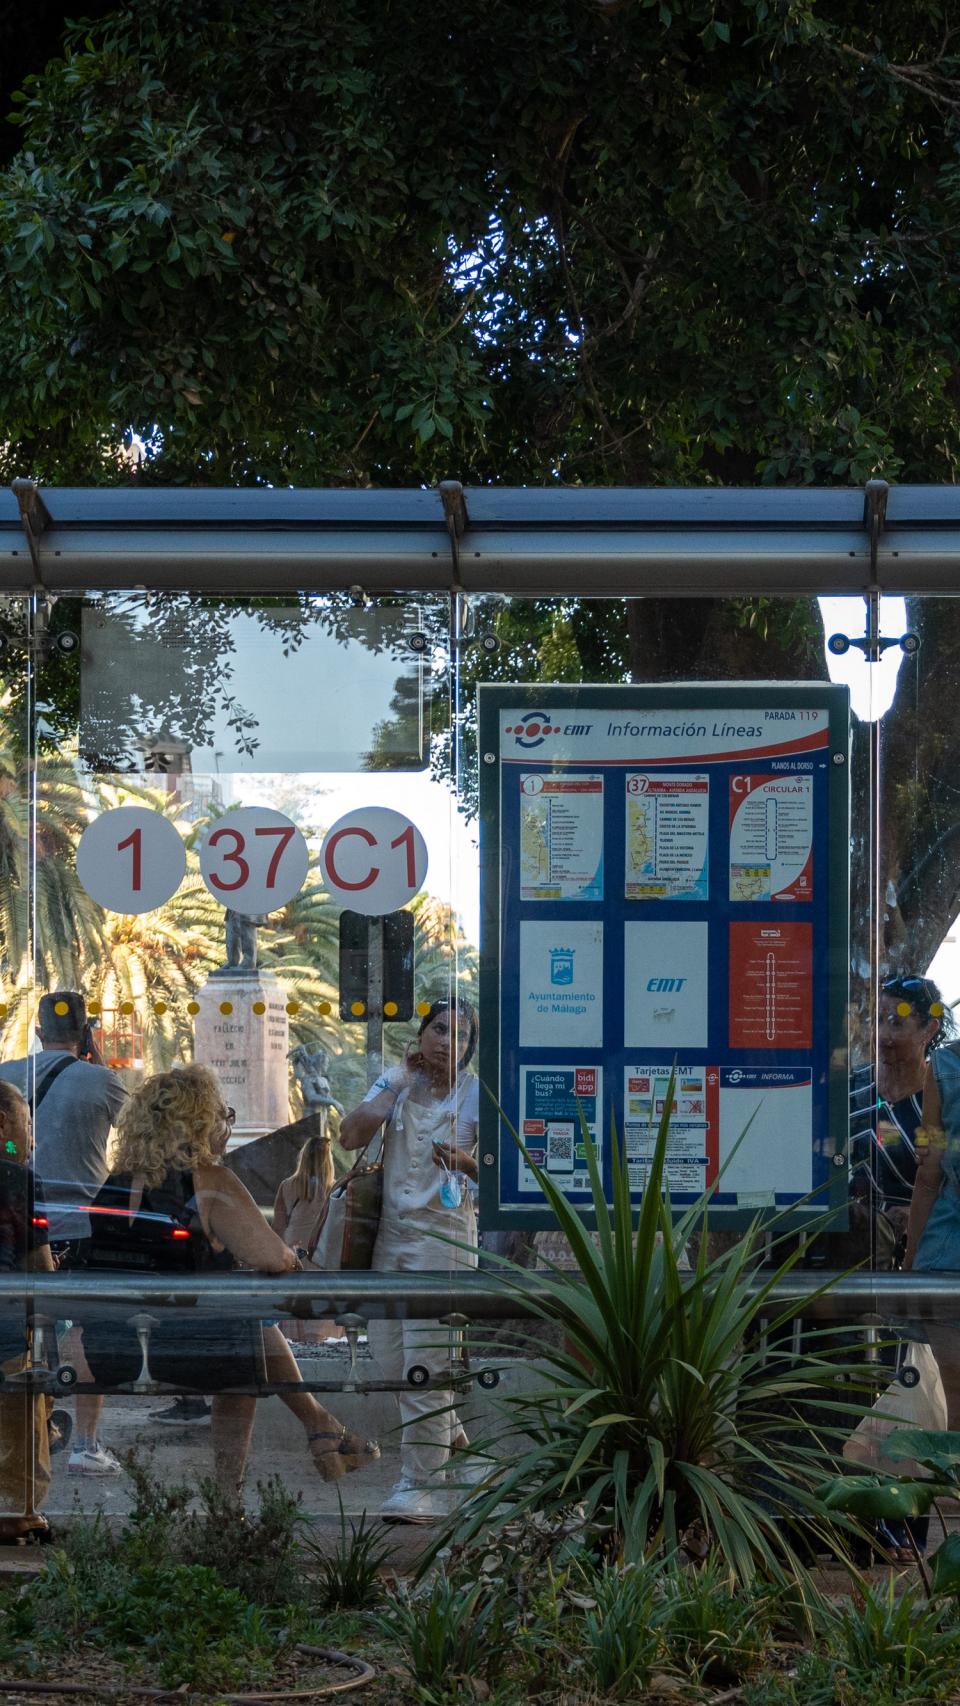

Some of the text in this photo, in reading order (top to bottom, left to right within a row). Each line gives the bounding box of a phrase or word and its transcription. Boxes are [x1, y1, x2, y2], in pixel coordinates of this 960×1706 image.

[764, 711, 818, 721] PARADA 119
[563, 721, 763, 737] EMT Información Líneas
[771, 761, 814, 770] PLANOS AL DORSO
[631, 779, 647, 792] 37
[732, 776, 752, 793] C1
[117, 827, 142, 891] 1
[208, 826, 296, 892] 37
[324, 825, 417, 892] C1
[646, 978, 687, 993] EMT
[528, 992, 596, 1002] Ayuntamiento
[537, 1003, 587, 1015] de Málaga
[635, 1066, 693, 1076] Tarjetas EMT
[531, 1074, 565, 1083] ¿Cuándo
[577, 1074, 594, 1082] bidi
[535, 1082, 554, 1090] llega
[577, 1084, 594, 1092] app
[535, 1089, 553, 1097] bus?
